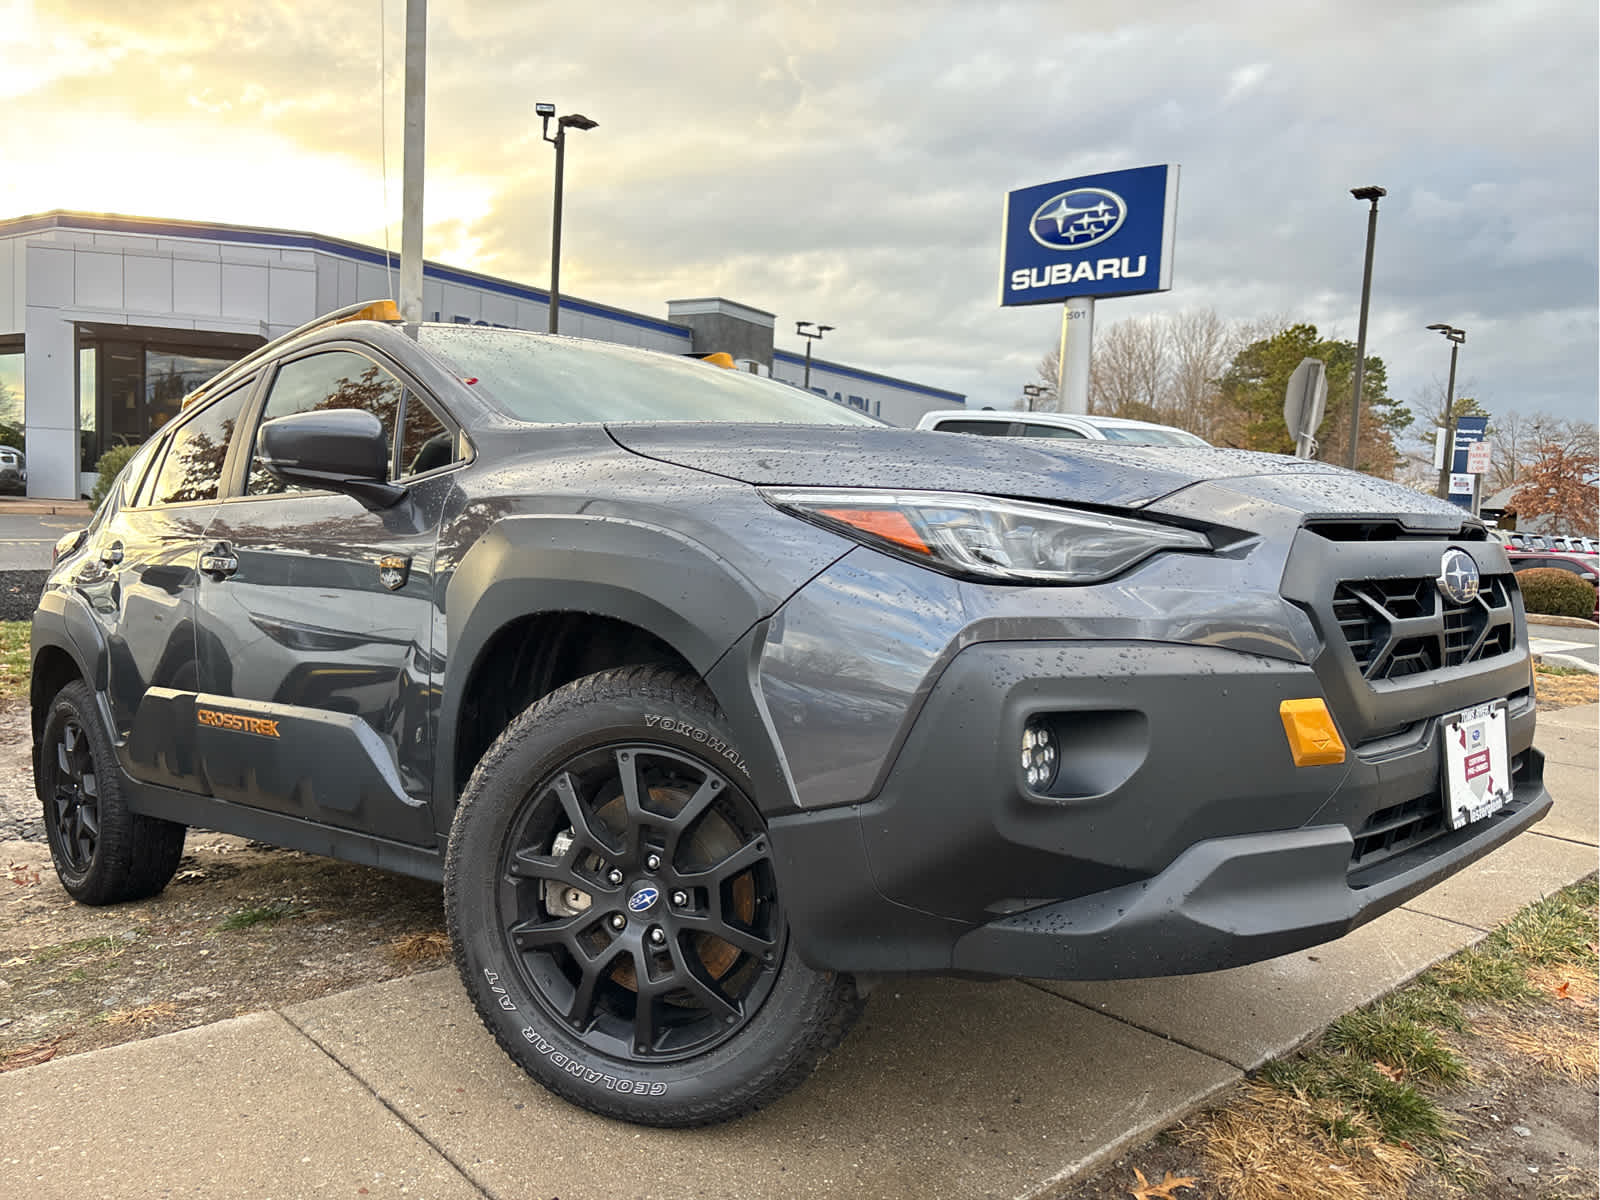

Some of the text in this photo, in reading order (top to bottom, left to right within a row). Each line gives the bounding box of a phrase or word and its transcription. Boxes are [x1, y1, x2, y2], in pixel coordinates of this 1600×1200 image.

[1011, 255, 1147, 291] SUBARU
[197, 709, 280, 737] CROSSTREK
[484, 967, 668, 1096] GEOLANDAR A/T
